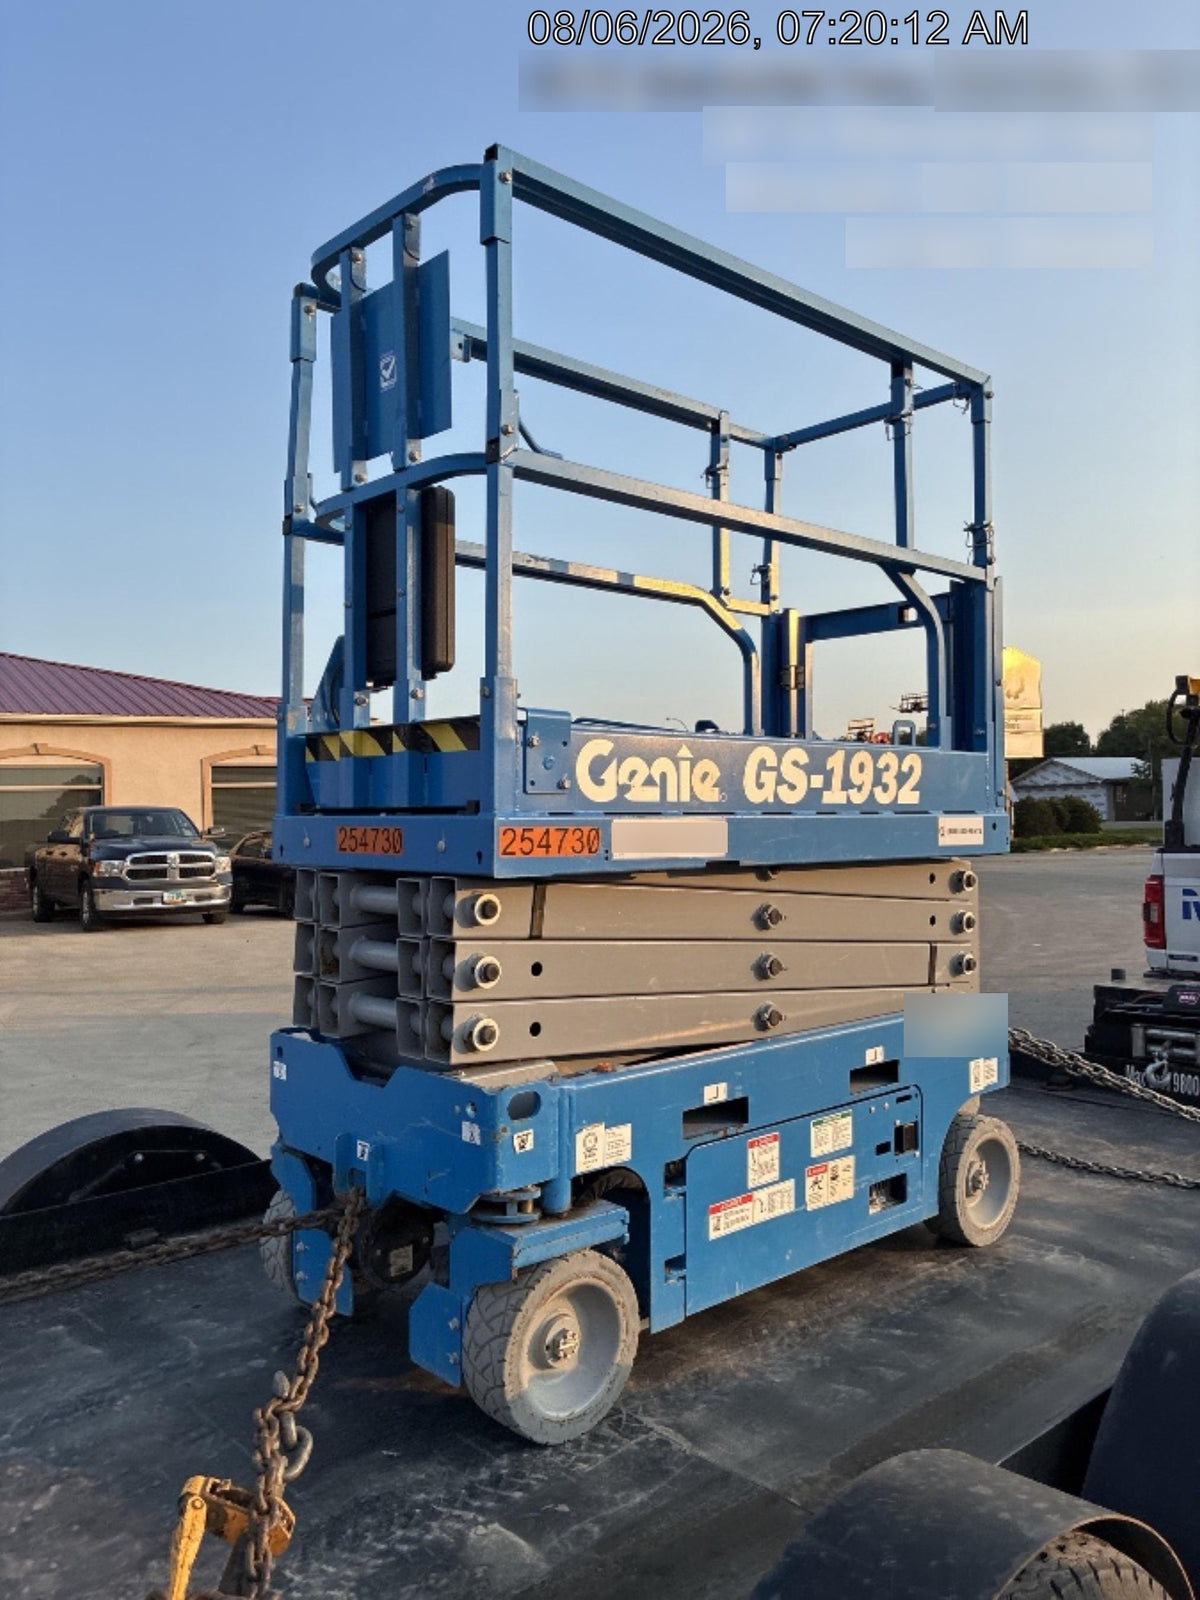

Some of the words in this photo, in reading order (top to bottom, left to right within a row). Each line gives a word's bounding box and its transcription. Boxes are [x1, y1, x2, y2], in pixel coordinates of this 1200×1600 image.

[575, 738, 720, 805] Genie
[742, 745, 923, 805] GS-1932
[338, 827, 404, 854] 254730
[501, 828, 600, 857] 254730
